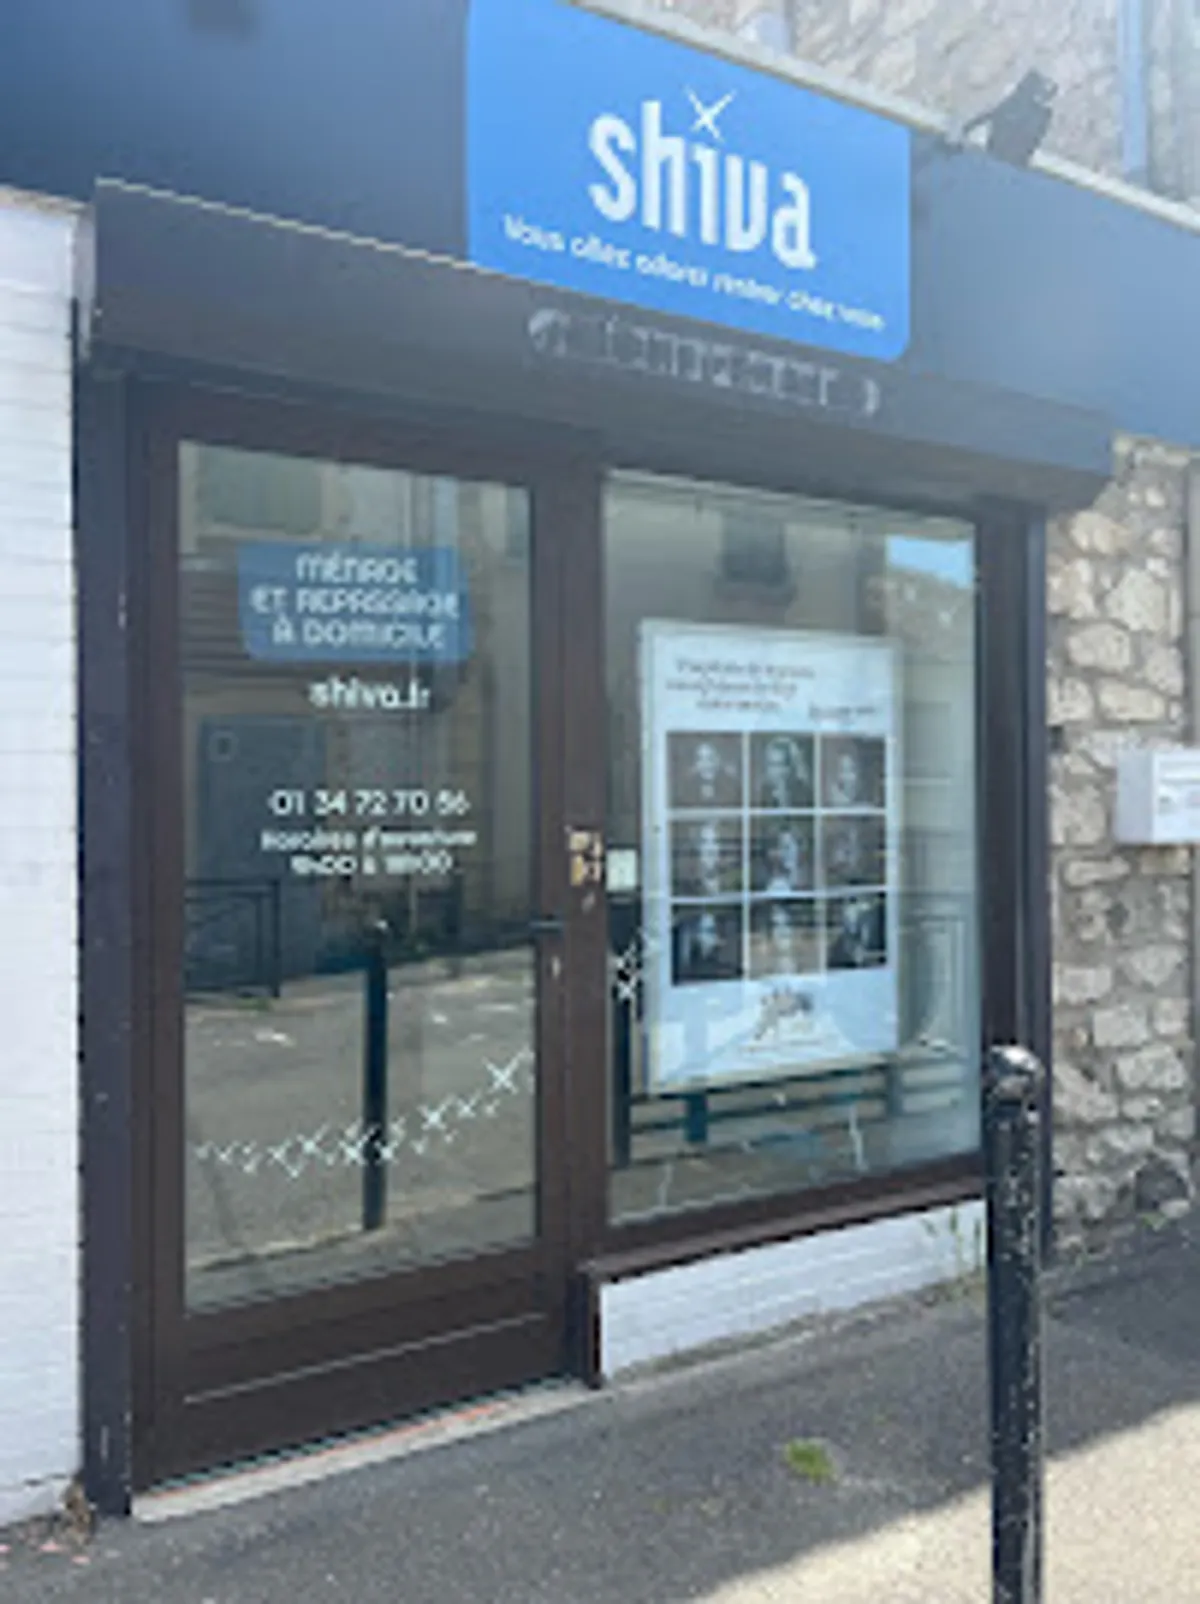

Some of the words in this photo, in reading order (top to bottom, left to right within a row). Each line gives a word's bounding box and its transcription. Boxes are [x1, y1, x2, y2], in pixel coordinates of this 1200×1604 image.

[588, 86, 818, 271] shiva
[269, 788, 305, 816] 01
[314, 789, 349, 816] 34
[354, 789, 388, 816] 72
[392, 789, 430, 816] 70
